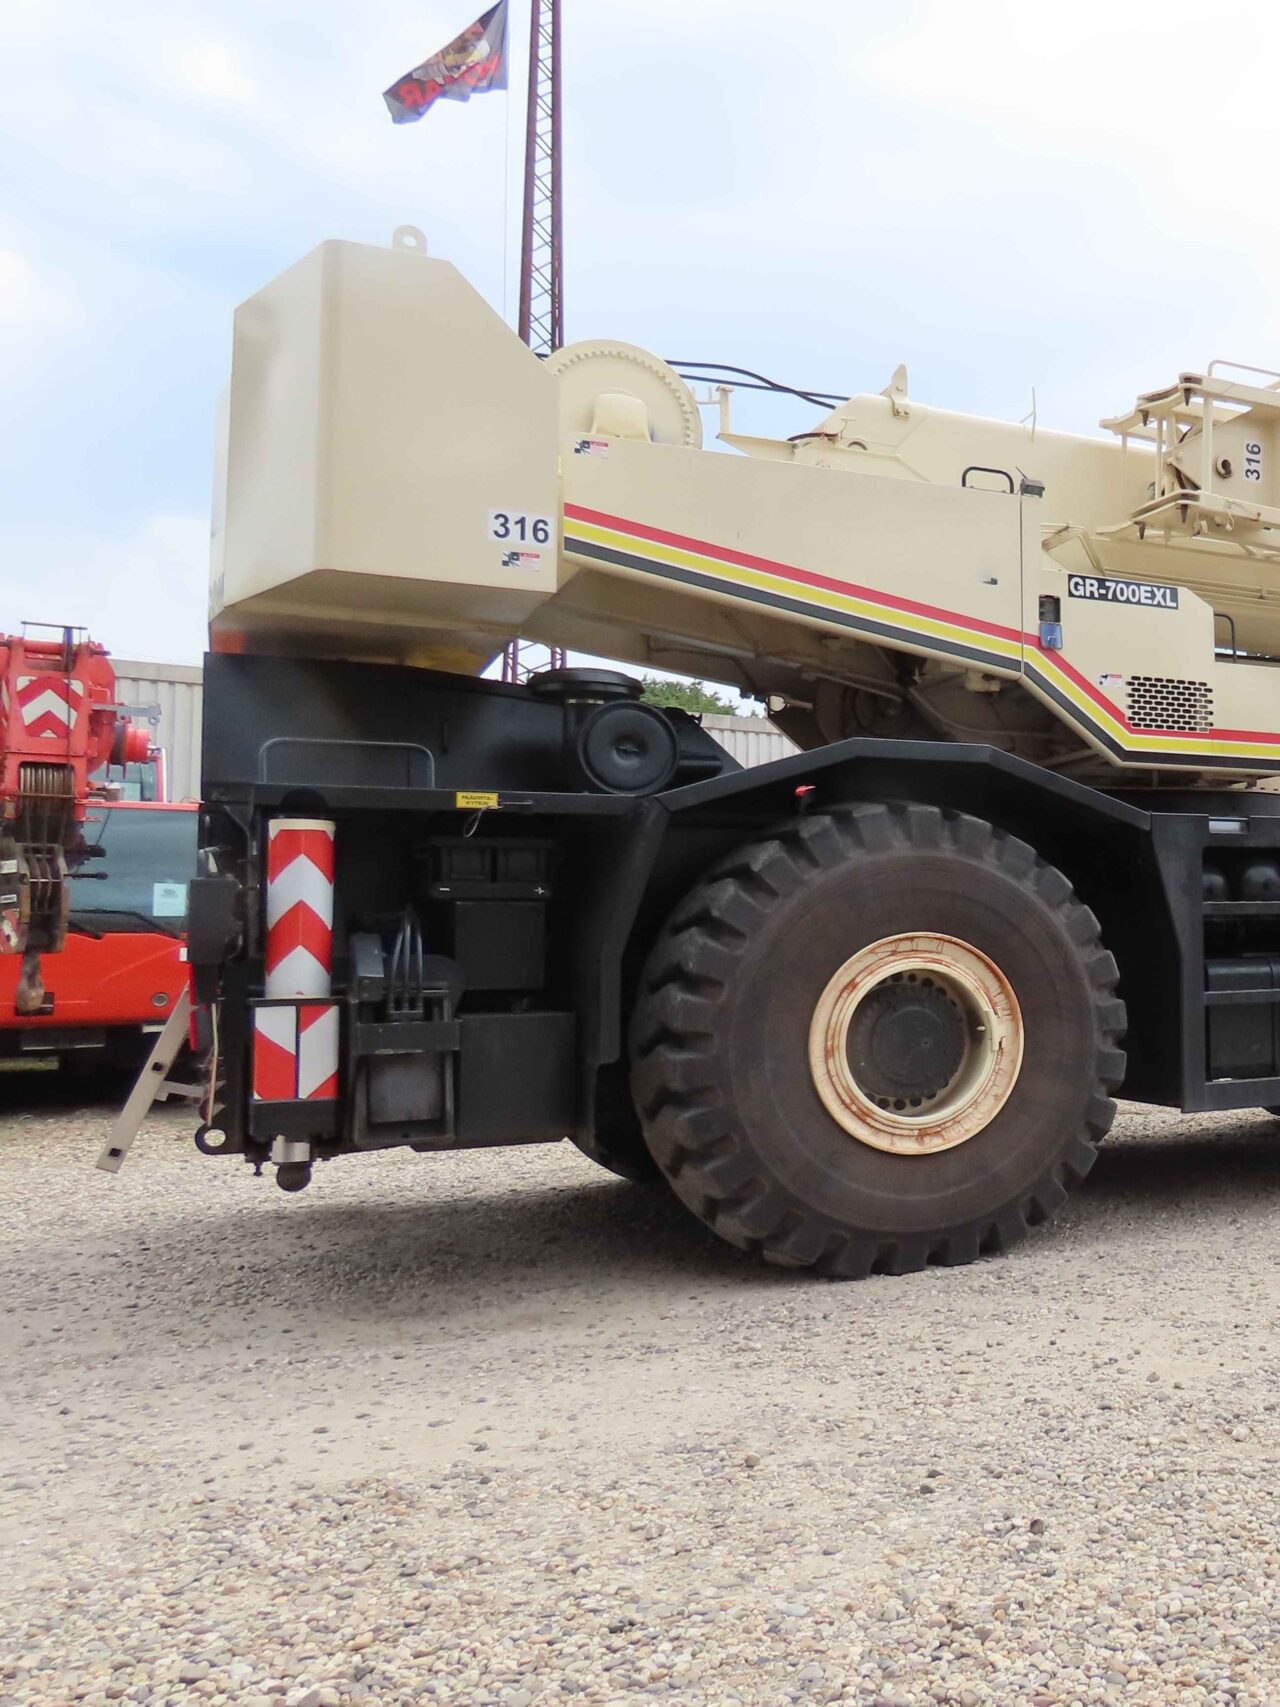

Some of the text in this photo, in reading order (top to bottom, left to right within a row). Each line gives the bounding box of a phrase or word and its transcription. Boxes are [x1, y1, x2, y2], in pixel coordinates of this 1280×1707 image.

[1245, 443, 1261, 481] 316
[493, 513, 549, 544] 316
[1069, 577, 1177, 607] GR-700EXL
